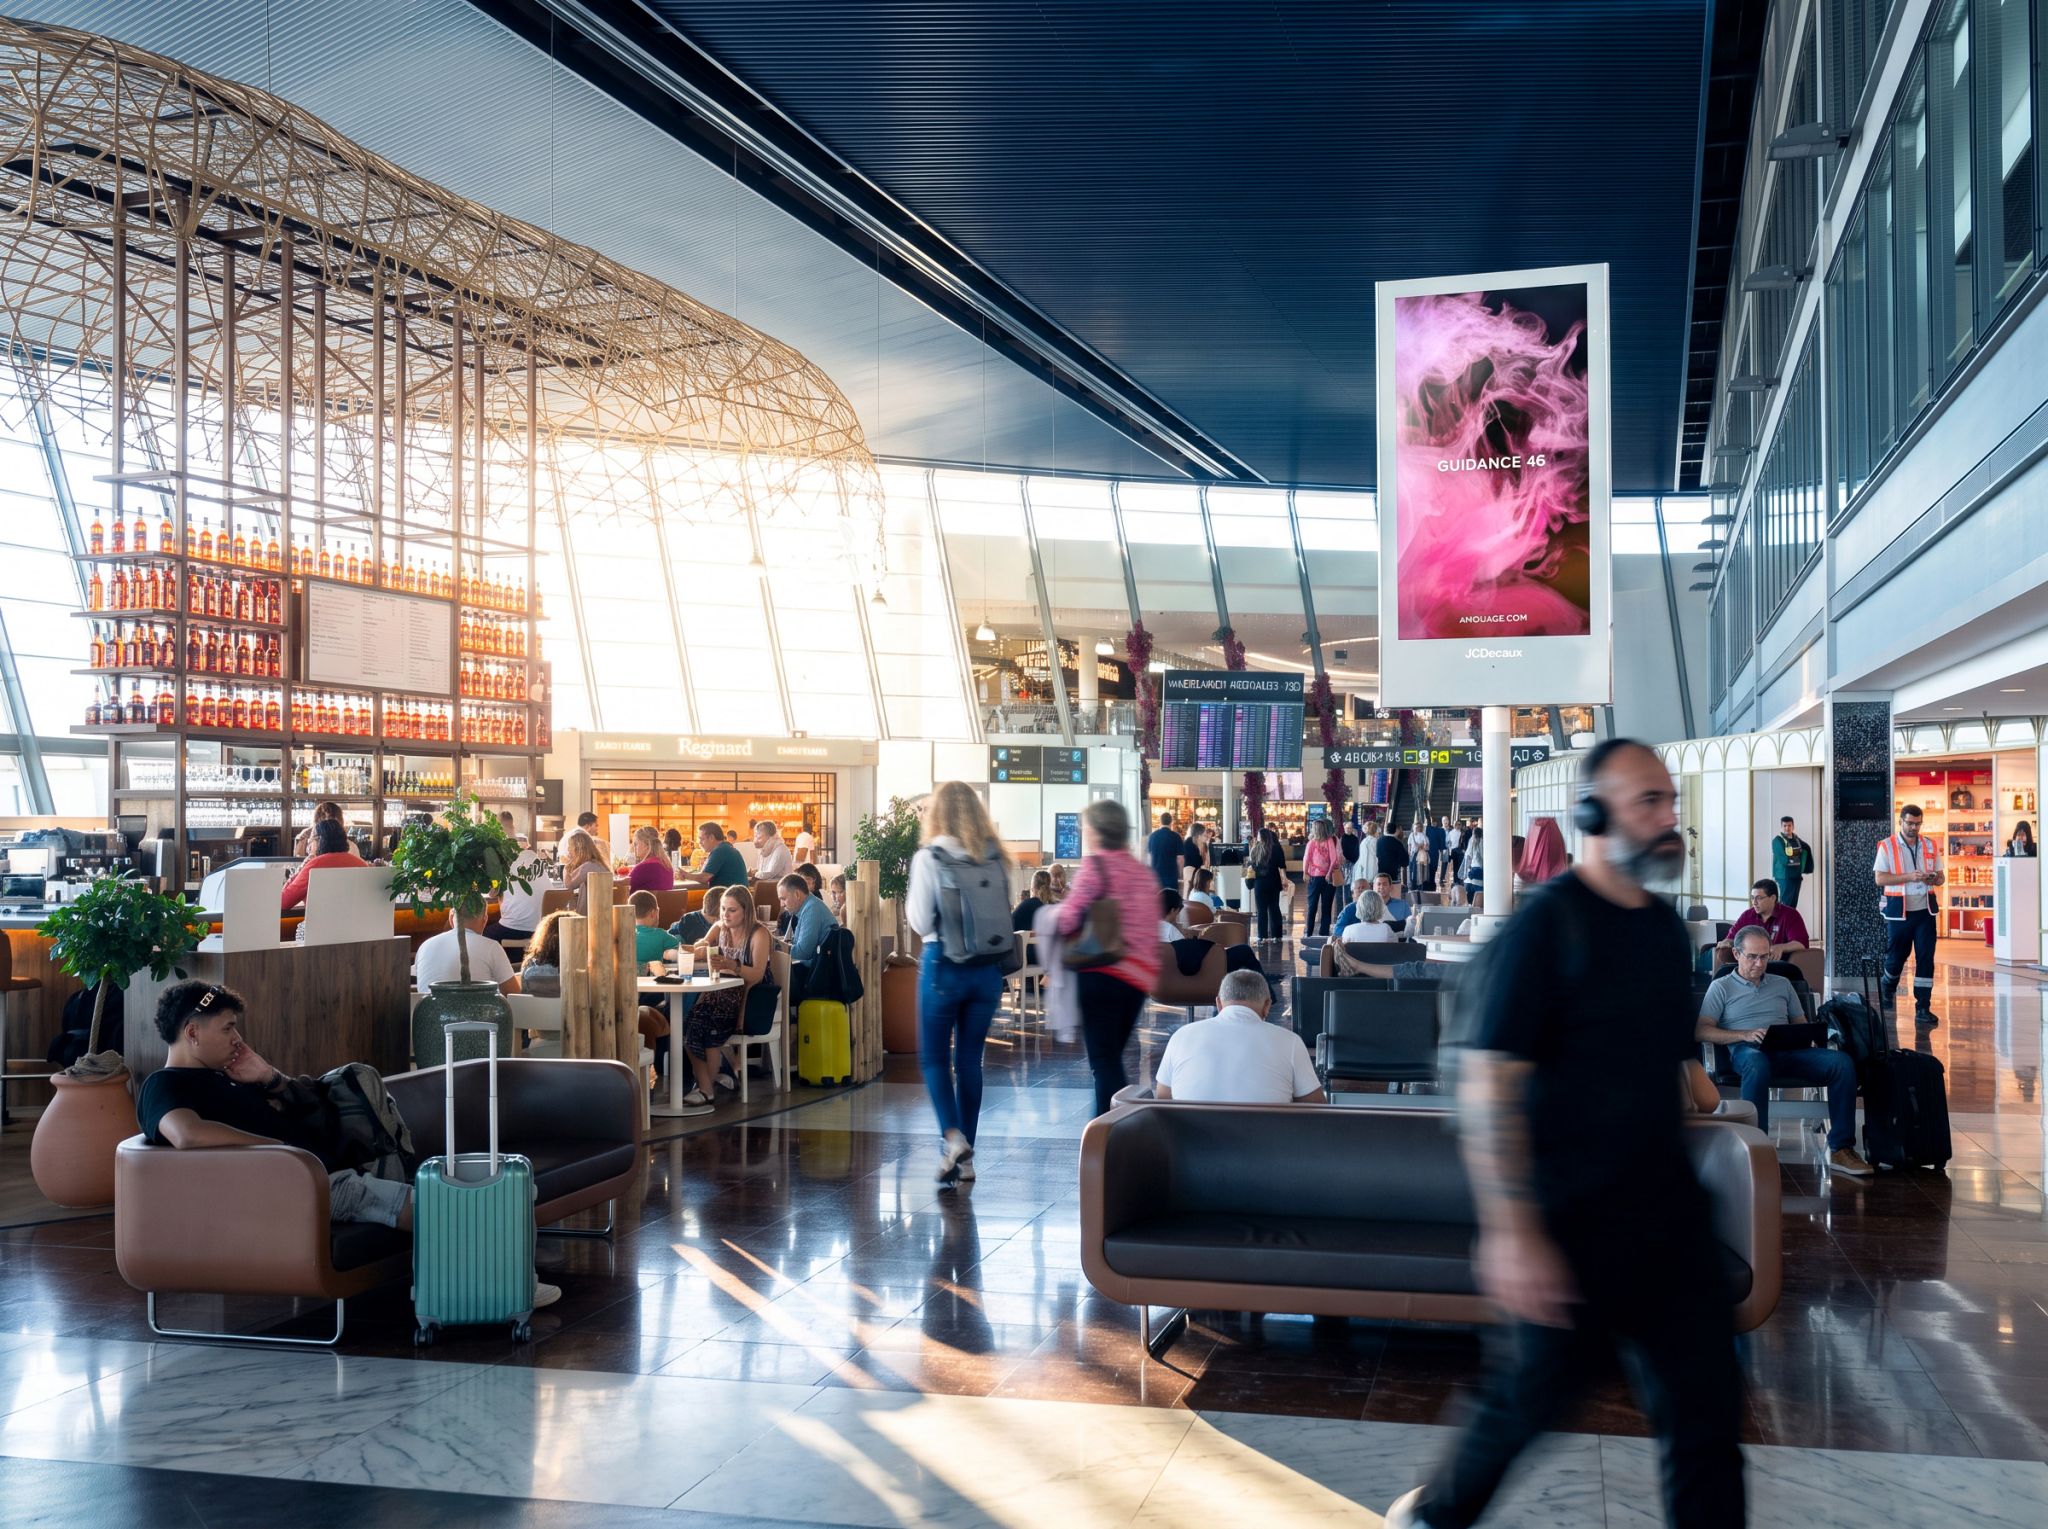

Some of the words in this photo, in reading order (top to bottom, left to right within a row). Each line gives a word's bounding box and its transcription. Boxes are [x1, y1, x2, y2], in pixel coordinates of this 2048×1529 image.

[1437, 455, 1522, 473] GUIDANCE
[1526, 454, 1546, 468] 46
[1464, 648, 1523, 659] JCDecaux
